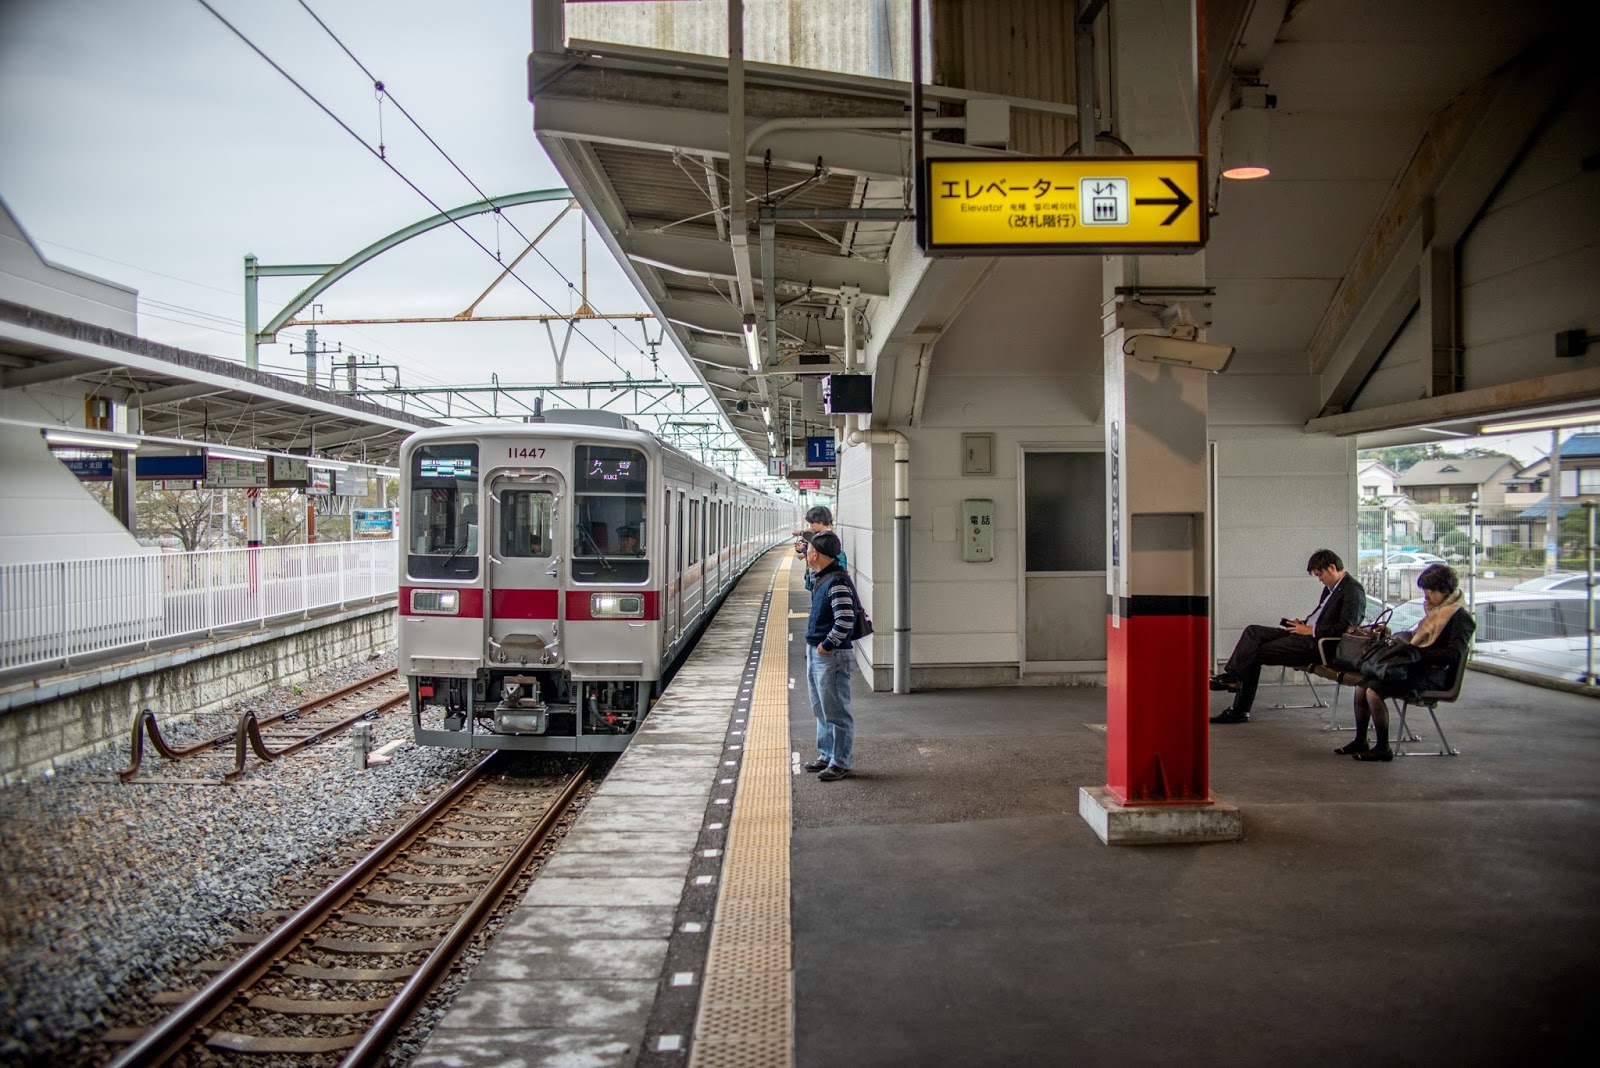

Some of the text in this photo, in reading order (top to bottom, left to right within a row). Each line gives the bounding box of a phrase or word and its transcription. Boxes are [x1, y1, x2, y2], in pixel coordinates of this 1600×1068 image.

[941, 178, 1075, 199] エレベーター
[960, 203, 1004, 212] Elevator
[1034, 203, 1077, 211] 엘리베이터
[508, 447, 546, 459] 11447
[814, 443, 819, 457] 1
[772, 460, 776, 470] 1
[970, 515, 990, 525] 電話
